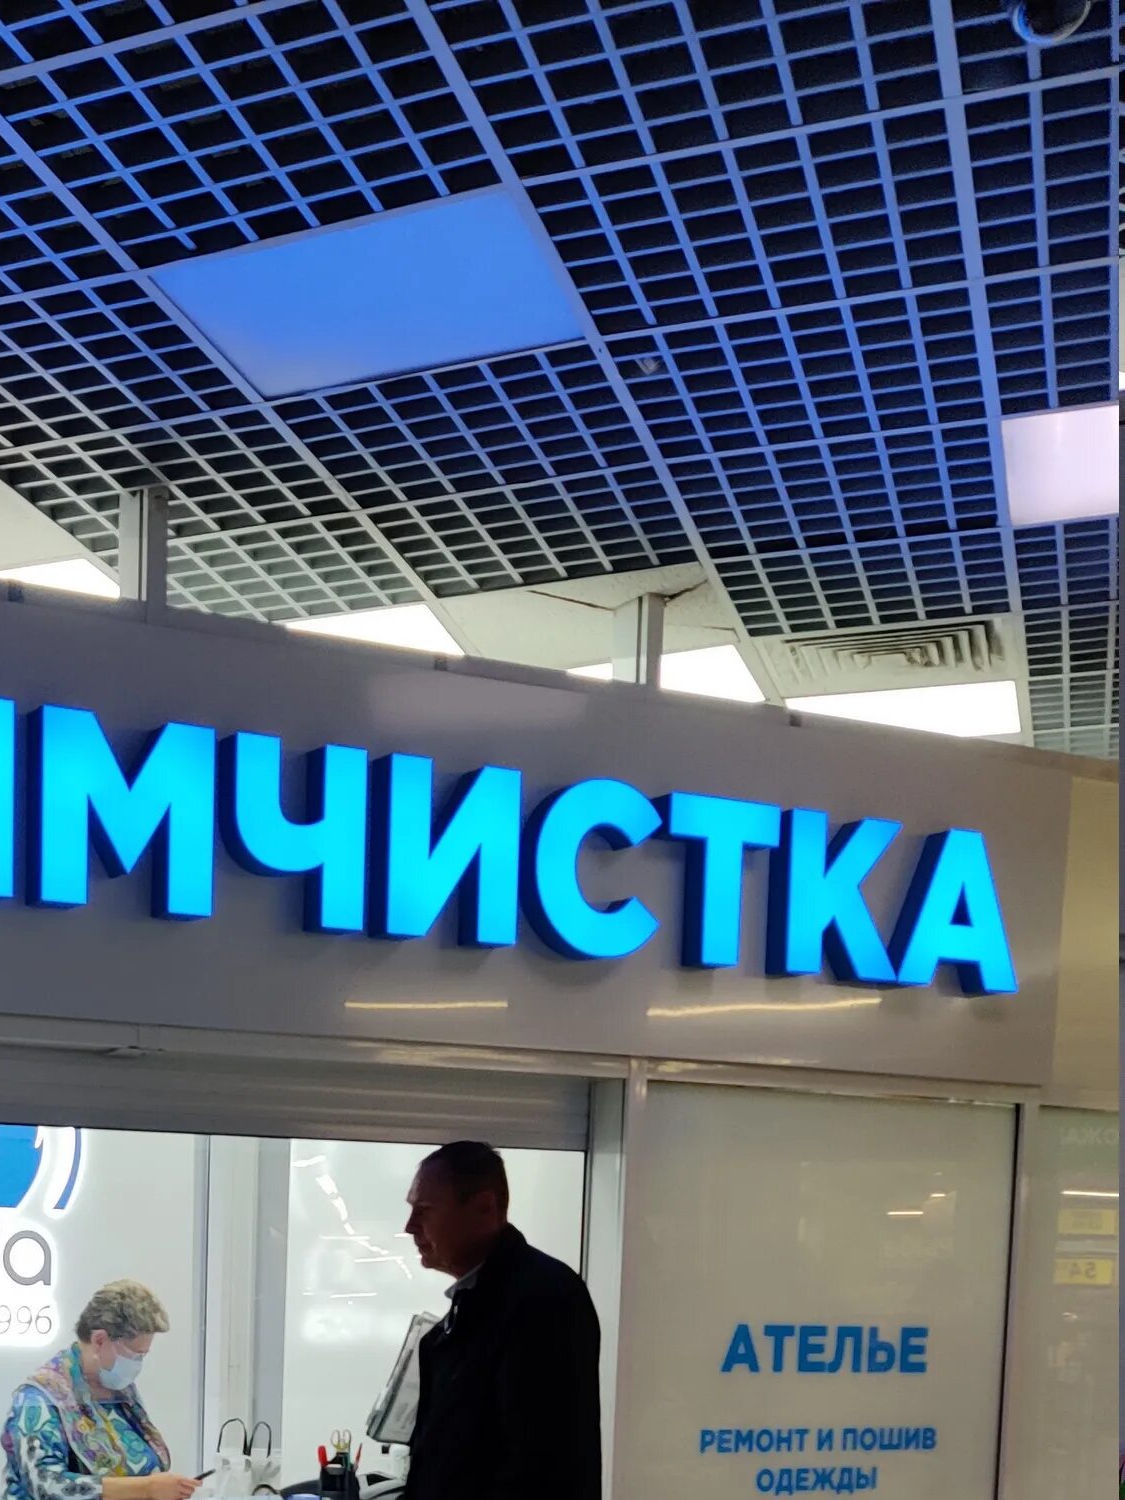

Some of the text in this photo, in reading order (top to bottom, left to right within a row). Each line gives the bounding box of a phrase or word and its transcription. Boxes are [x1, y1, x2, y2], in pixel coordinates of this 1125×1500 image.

[721, 1324, 929, 1373] АТЕЛЬЕ
[699, 1427, 936, 1454] РЕМОНТ И ПОШИВ
[756, 1467, 878, 1495] ОДЕЖДЫ
